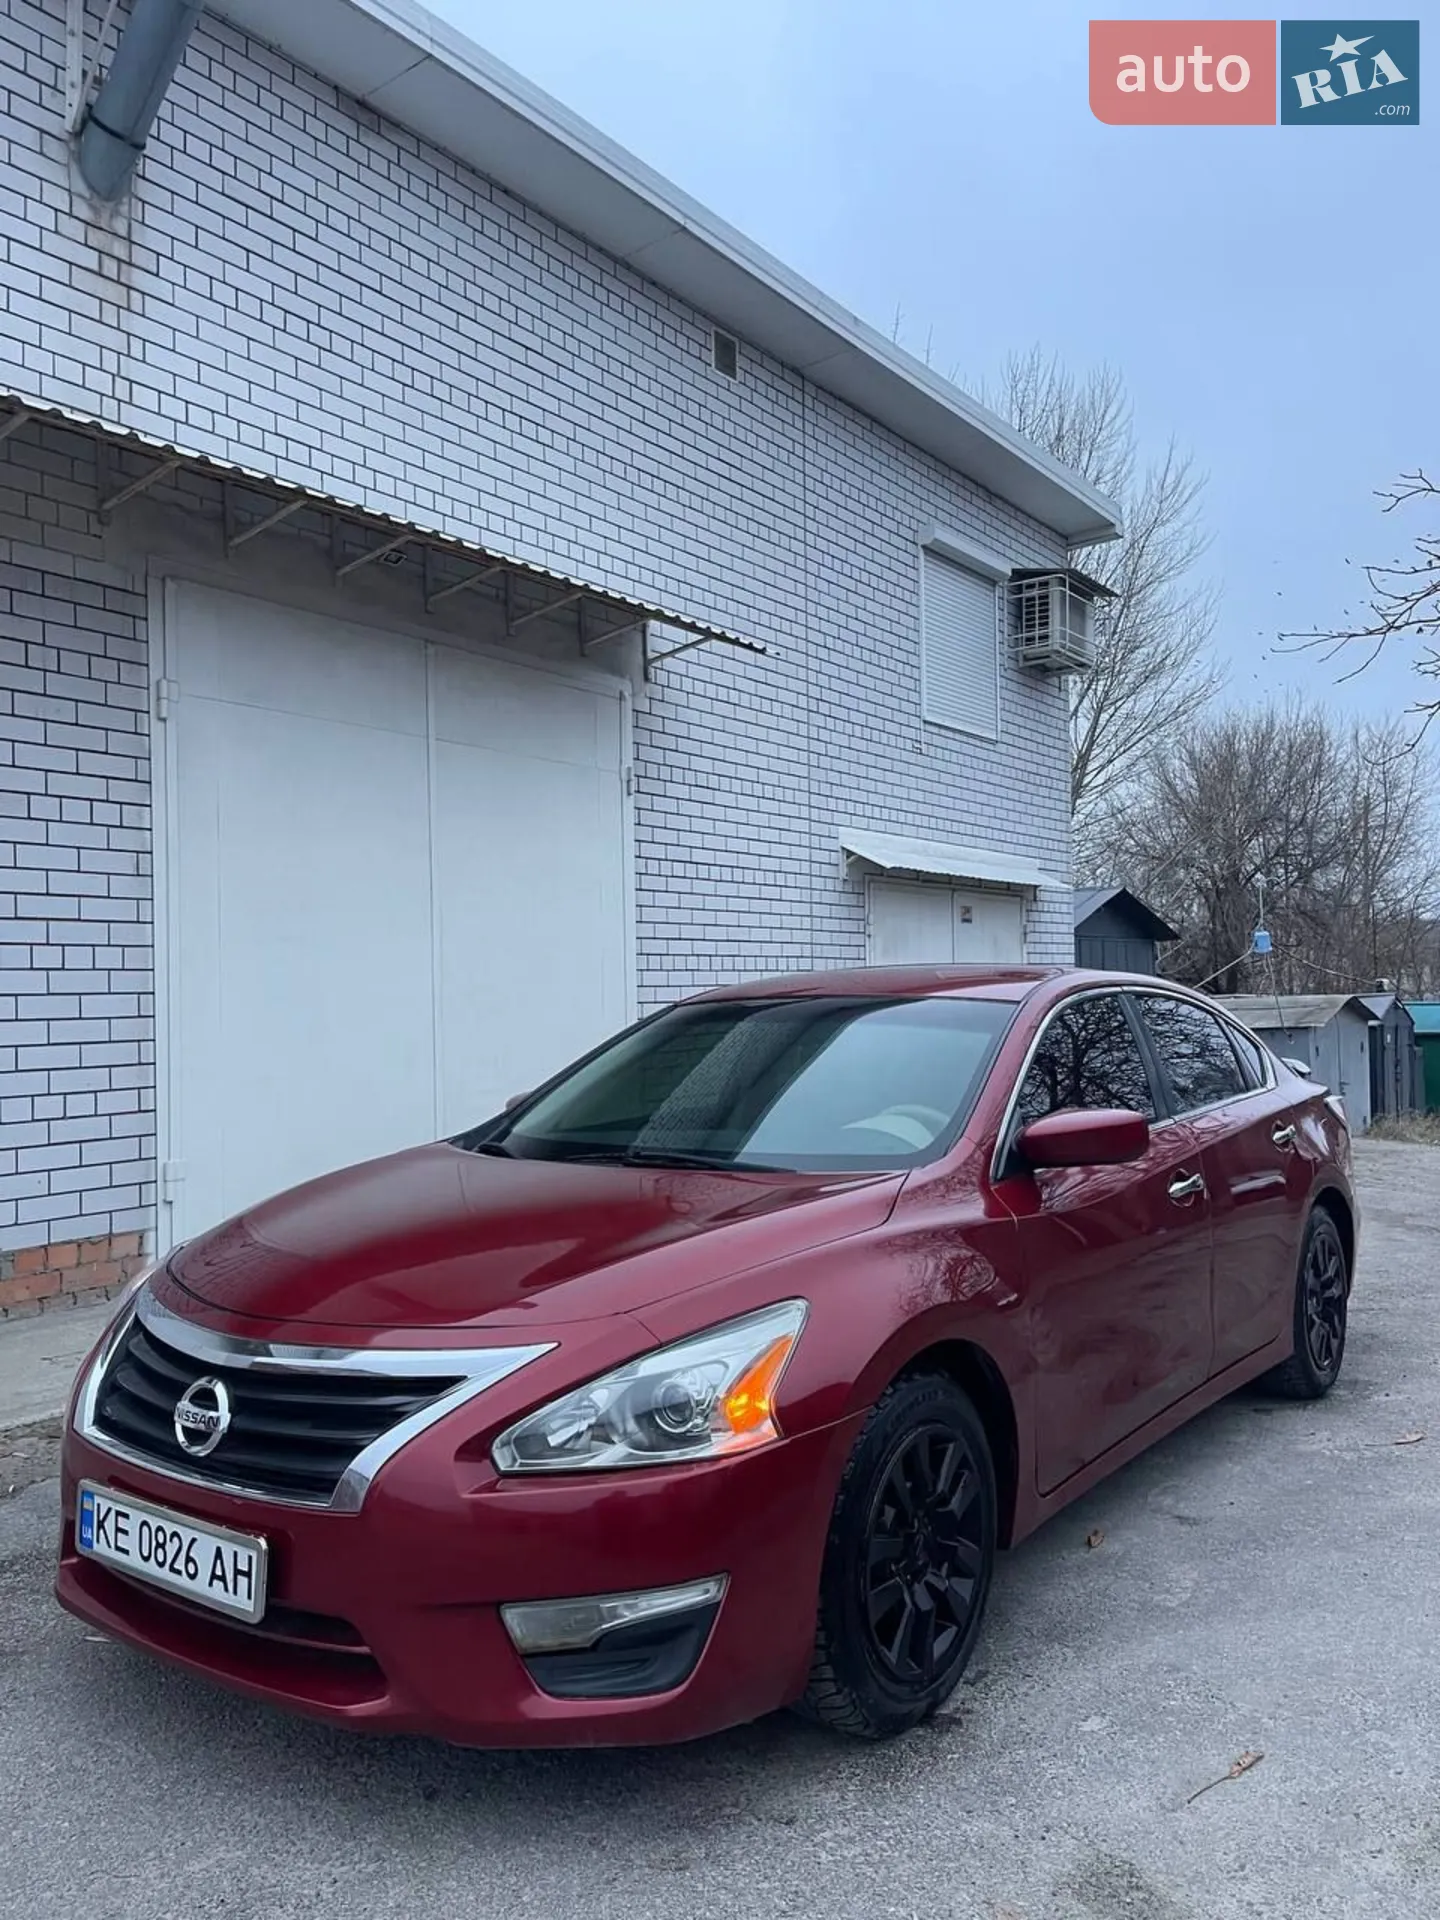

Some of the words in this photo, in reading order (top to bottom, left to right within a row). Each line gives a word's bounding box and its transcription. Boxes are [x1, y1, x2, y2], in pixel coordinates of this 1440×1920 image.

[177, 1406, 222, 1430] NISSAN
[82, 1524, 93, 1540] UA
[96, 1502, 131, 1557] KE
[138, 1520, 199, 1581] 0826
[208, 1546, 253, 1601] AH
